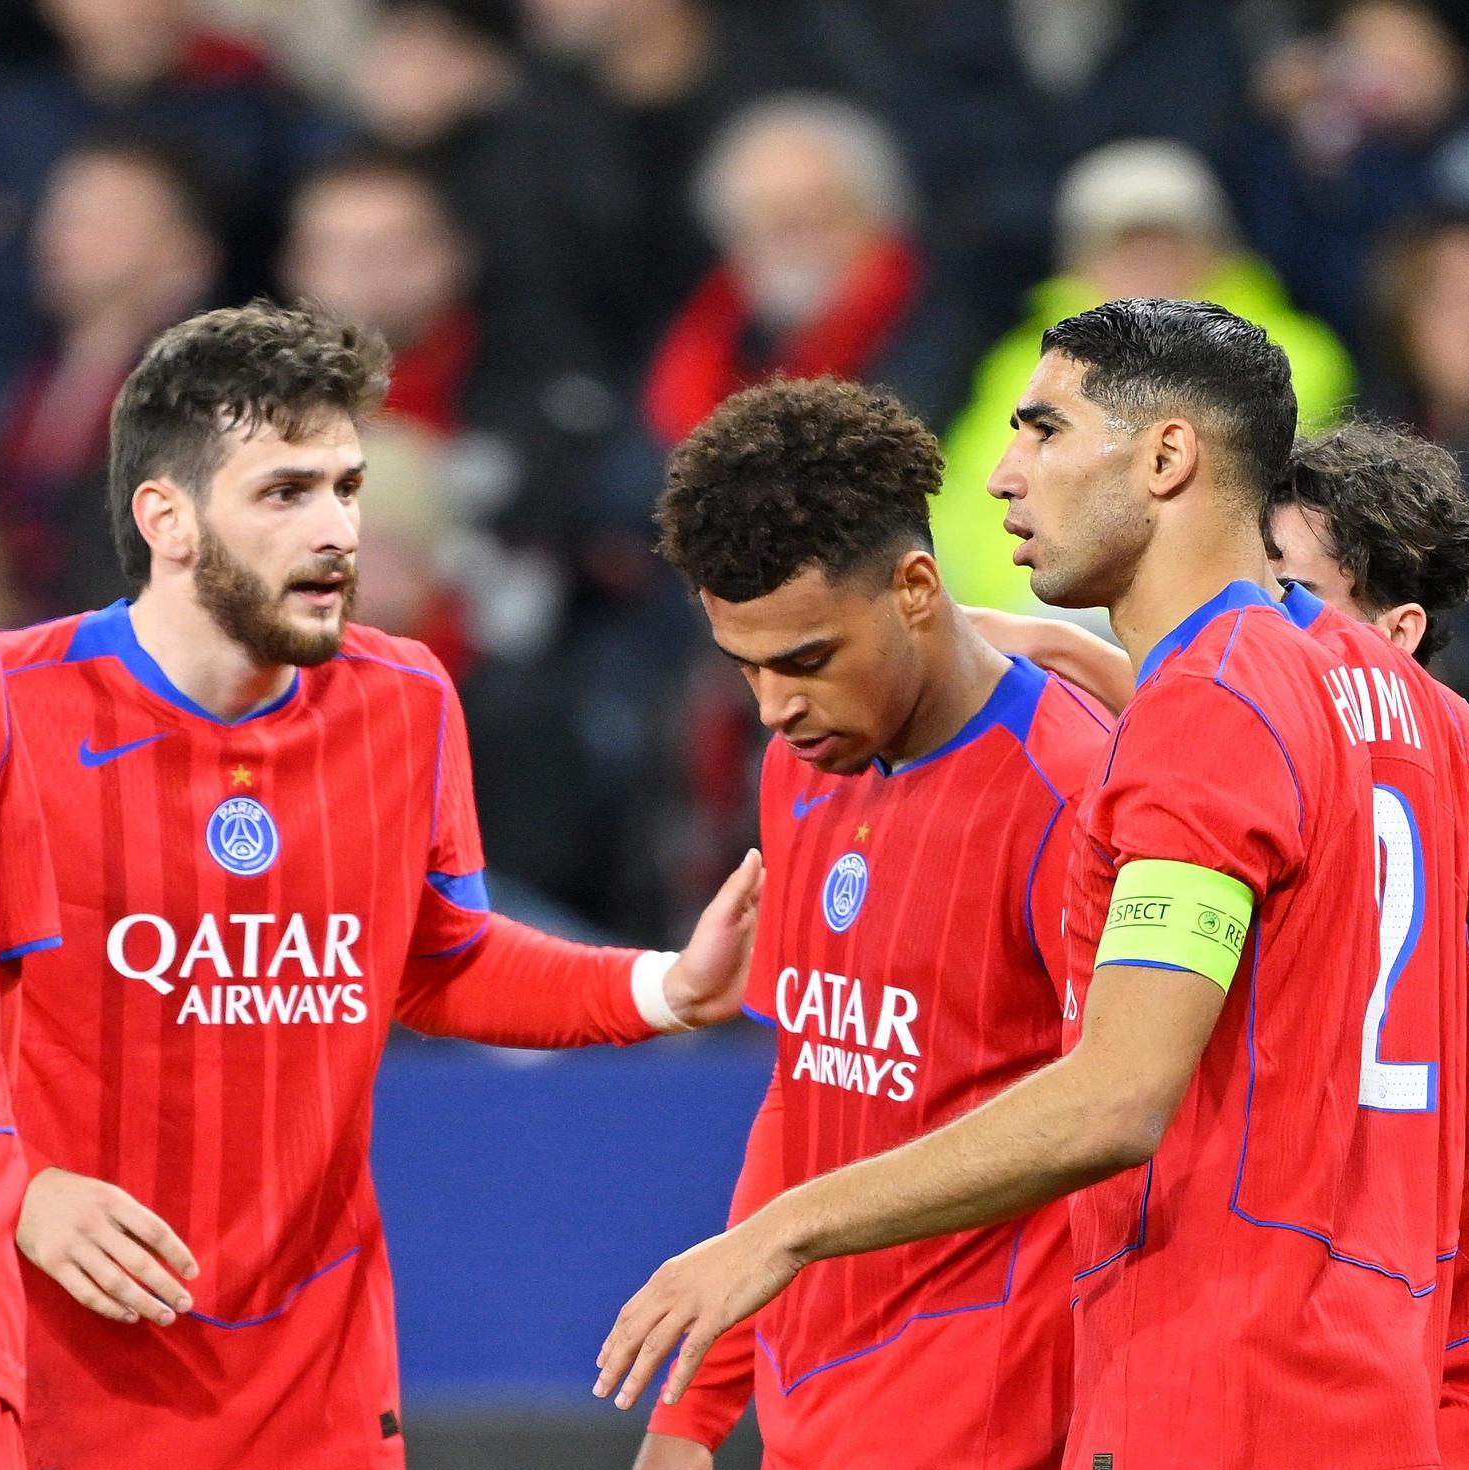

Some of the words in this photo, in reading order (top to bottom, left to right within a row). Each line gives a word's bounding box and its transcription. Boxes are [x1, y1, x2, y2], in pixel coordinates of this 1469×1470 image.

[217, 801, 262, 822] PARIS
[1108, 902, 1171, 925] ESPECT
[107, 912, 364, 995] QATAR
[1358, 783, 1438, 1113] 2
[176, 983, 368, 1025] AIRWAYS
